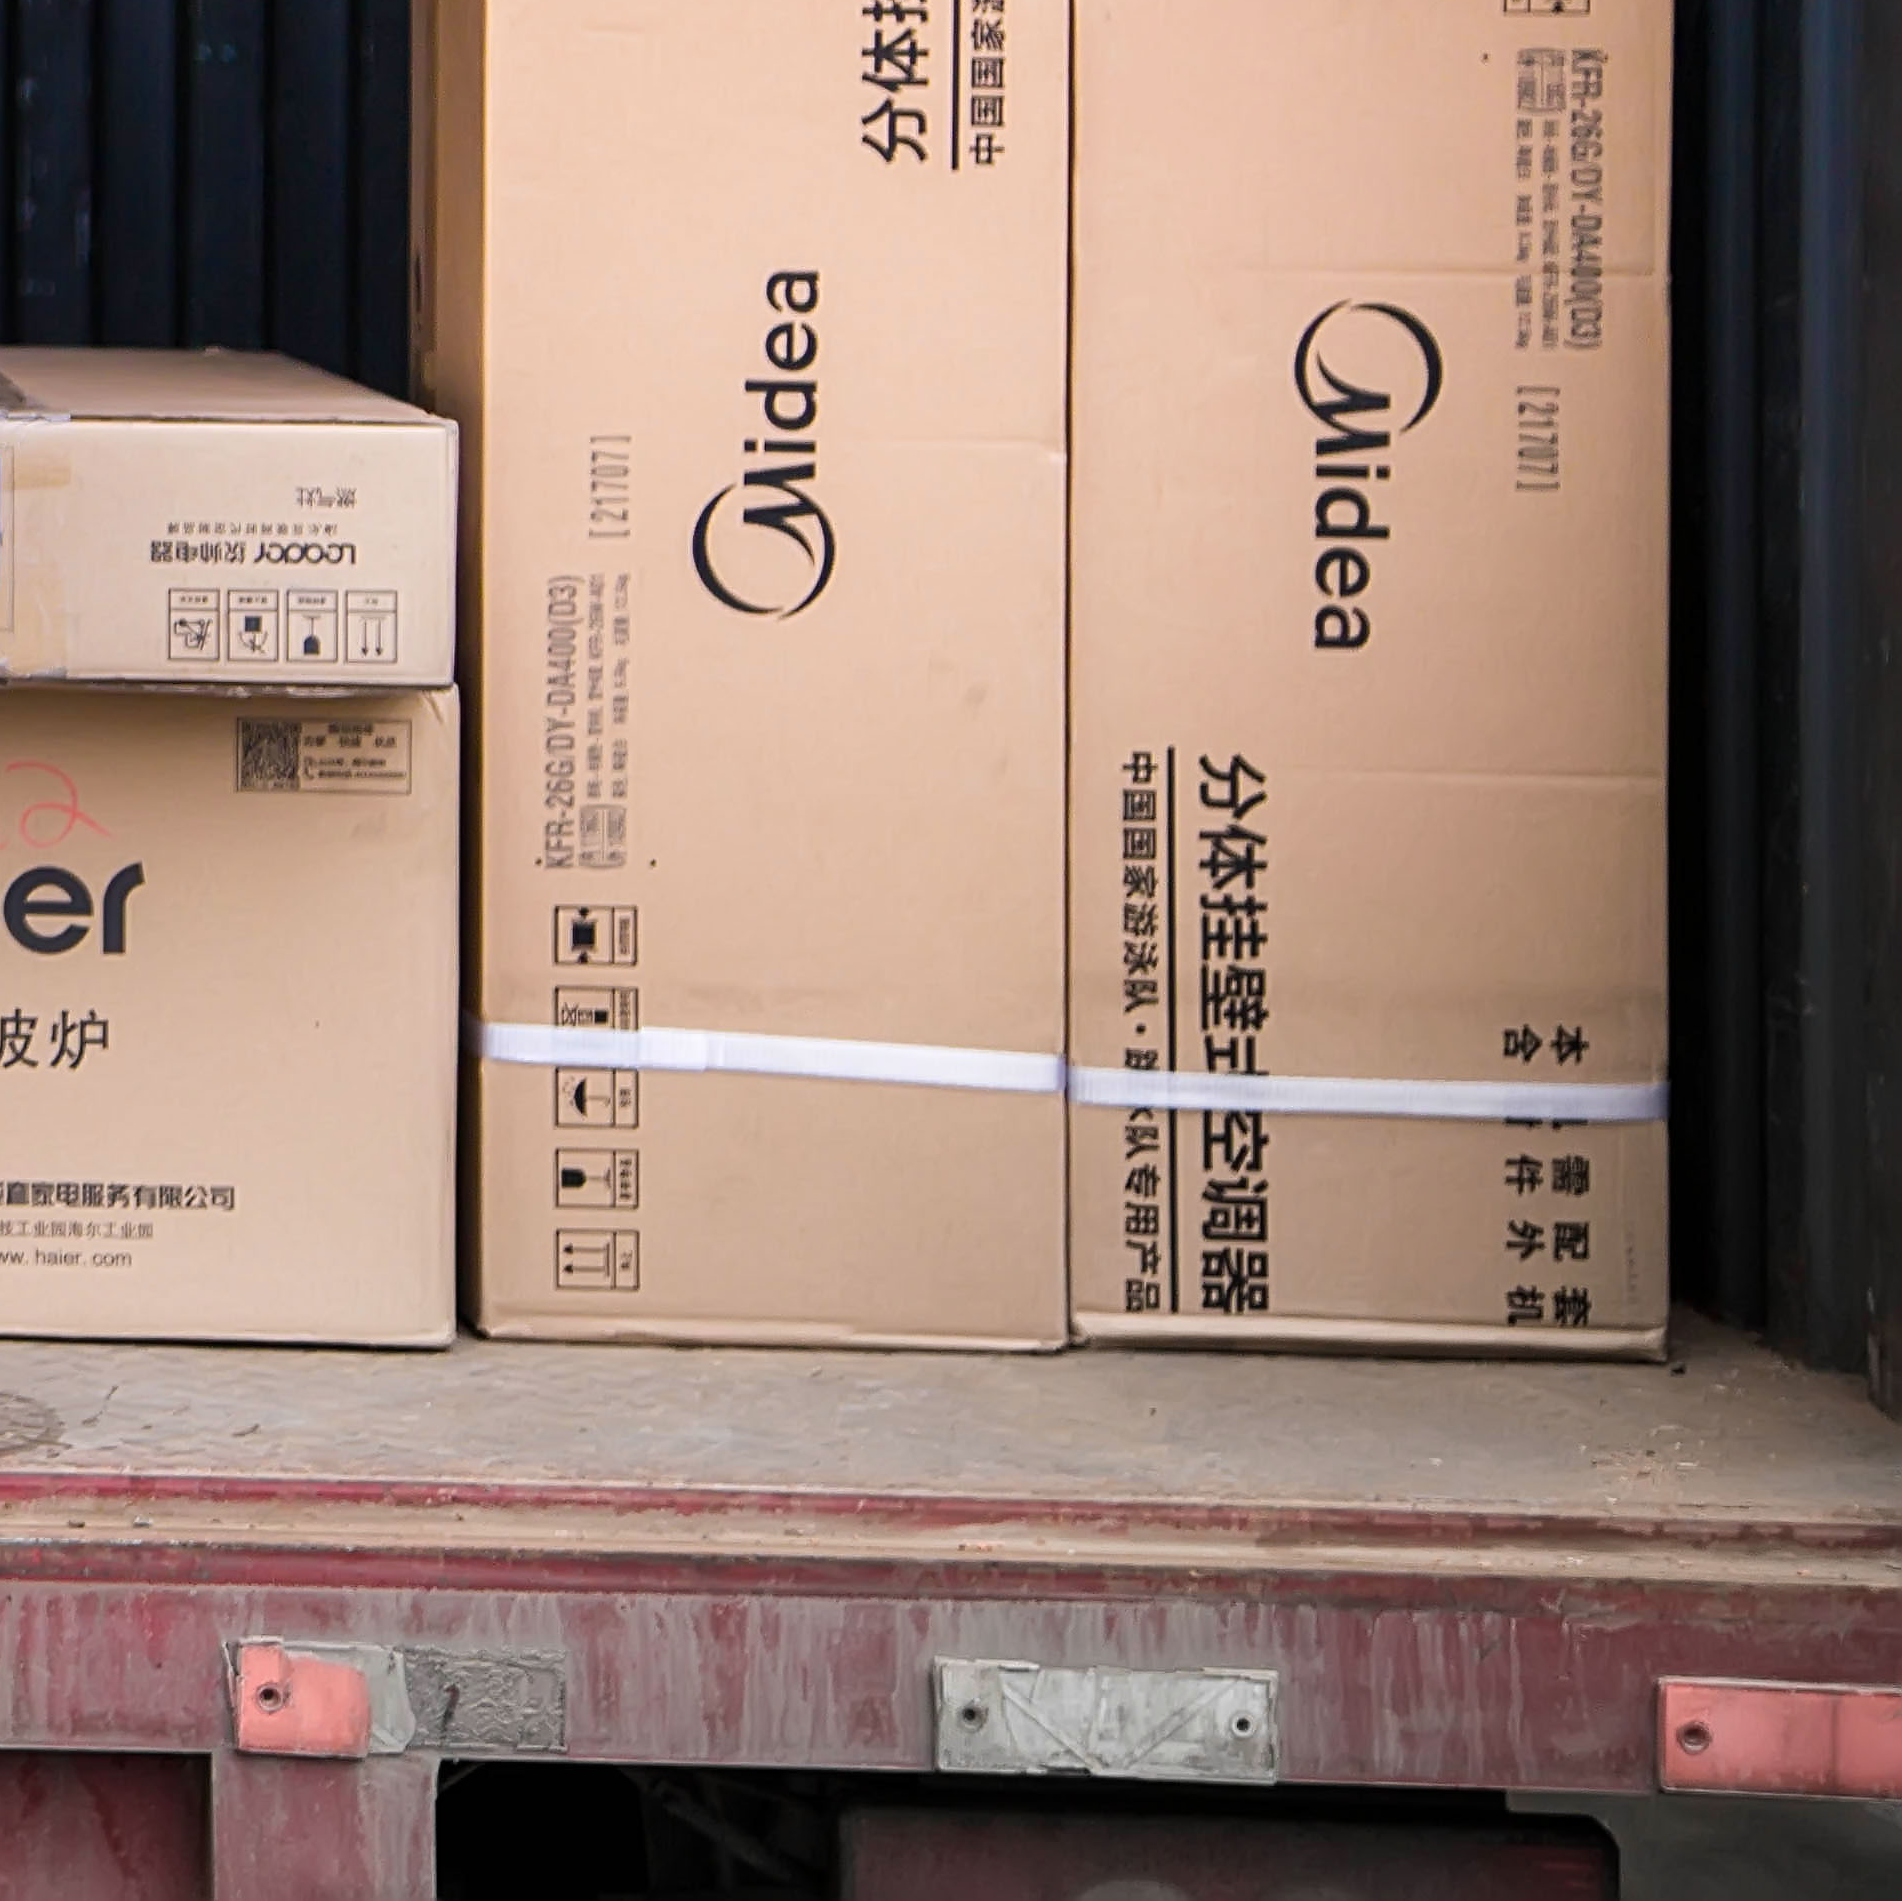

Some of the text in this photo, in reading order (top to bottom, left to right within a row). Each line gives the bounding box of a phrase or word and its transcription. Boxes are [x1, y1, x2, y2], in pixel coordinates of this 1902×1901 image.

[692, 269, 836, 622] Midea
[1294, 298, 1443, 652] Midea
[1502, 1024, 1545, 1325] 含件外机
[1550, 1024, 1592, 1326] 本需配套
